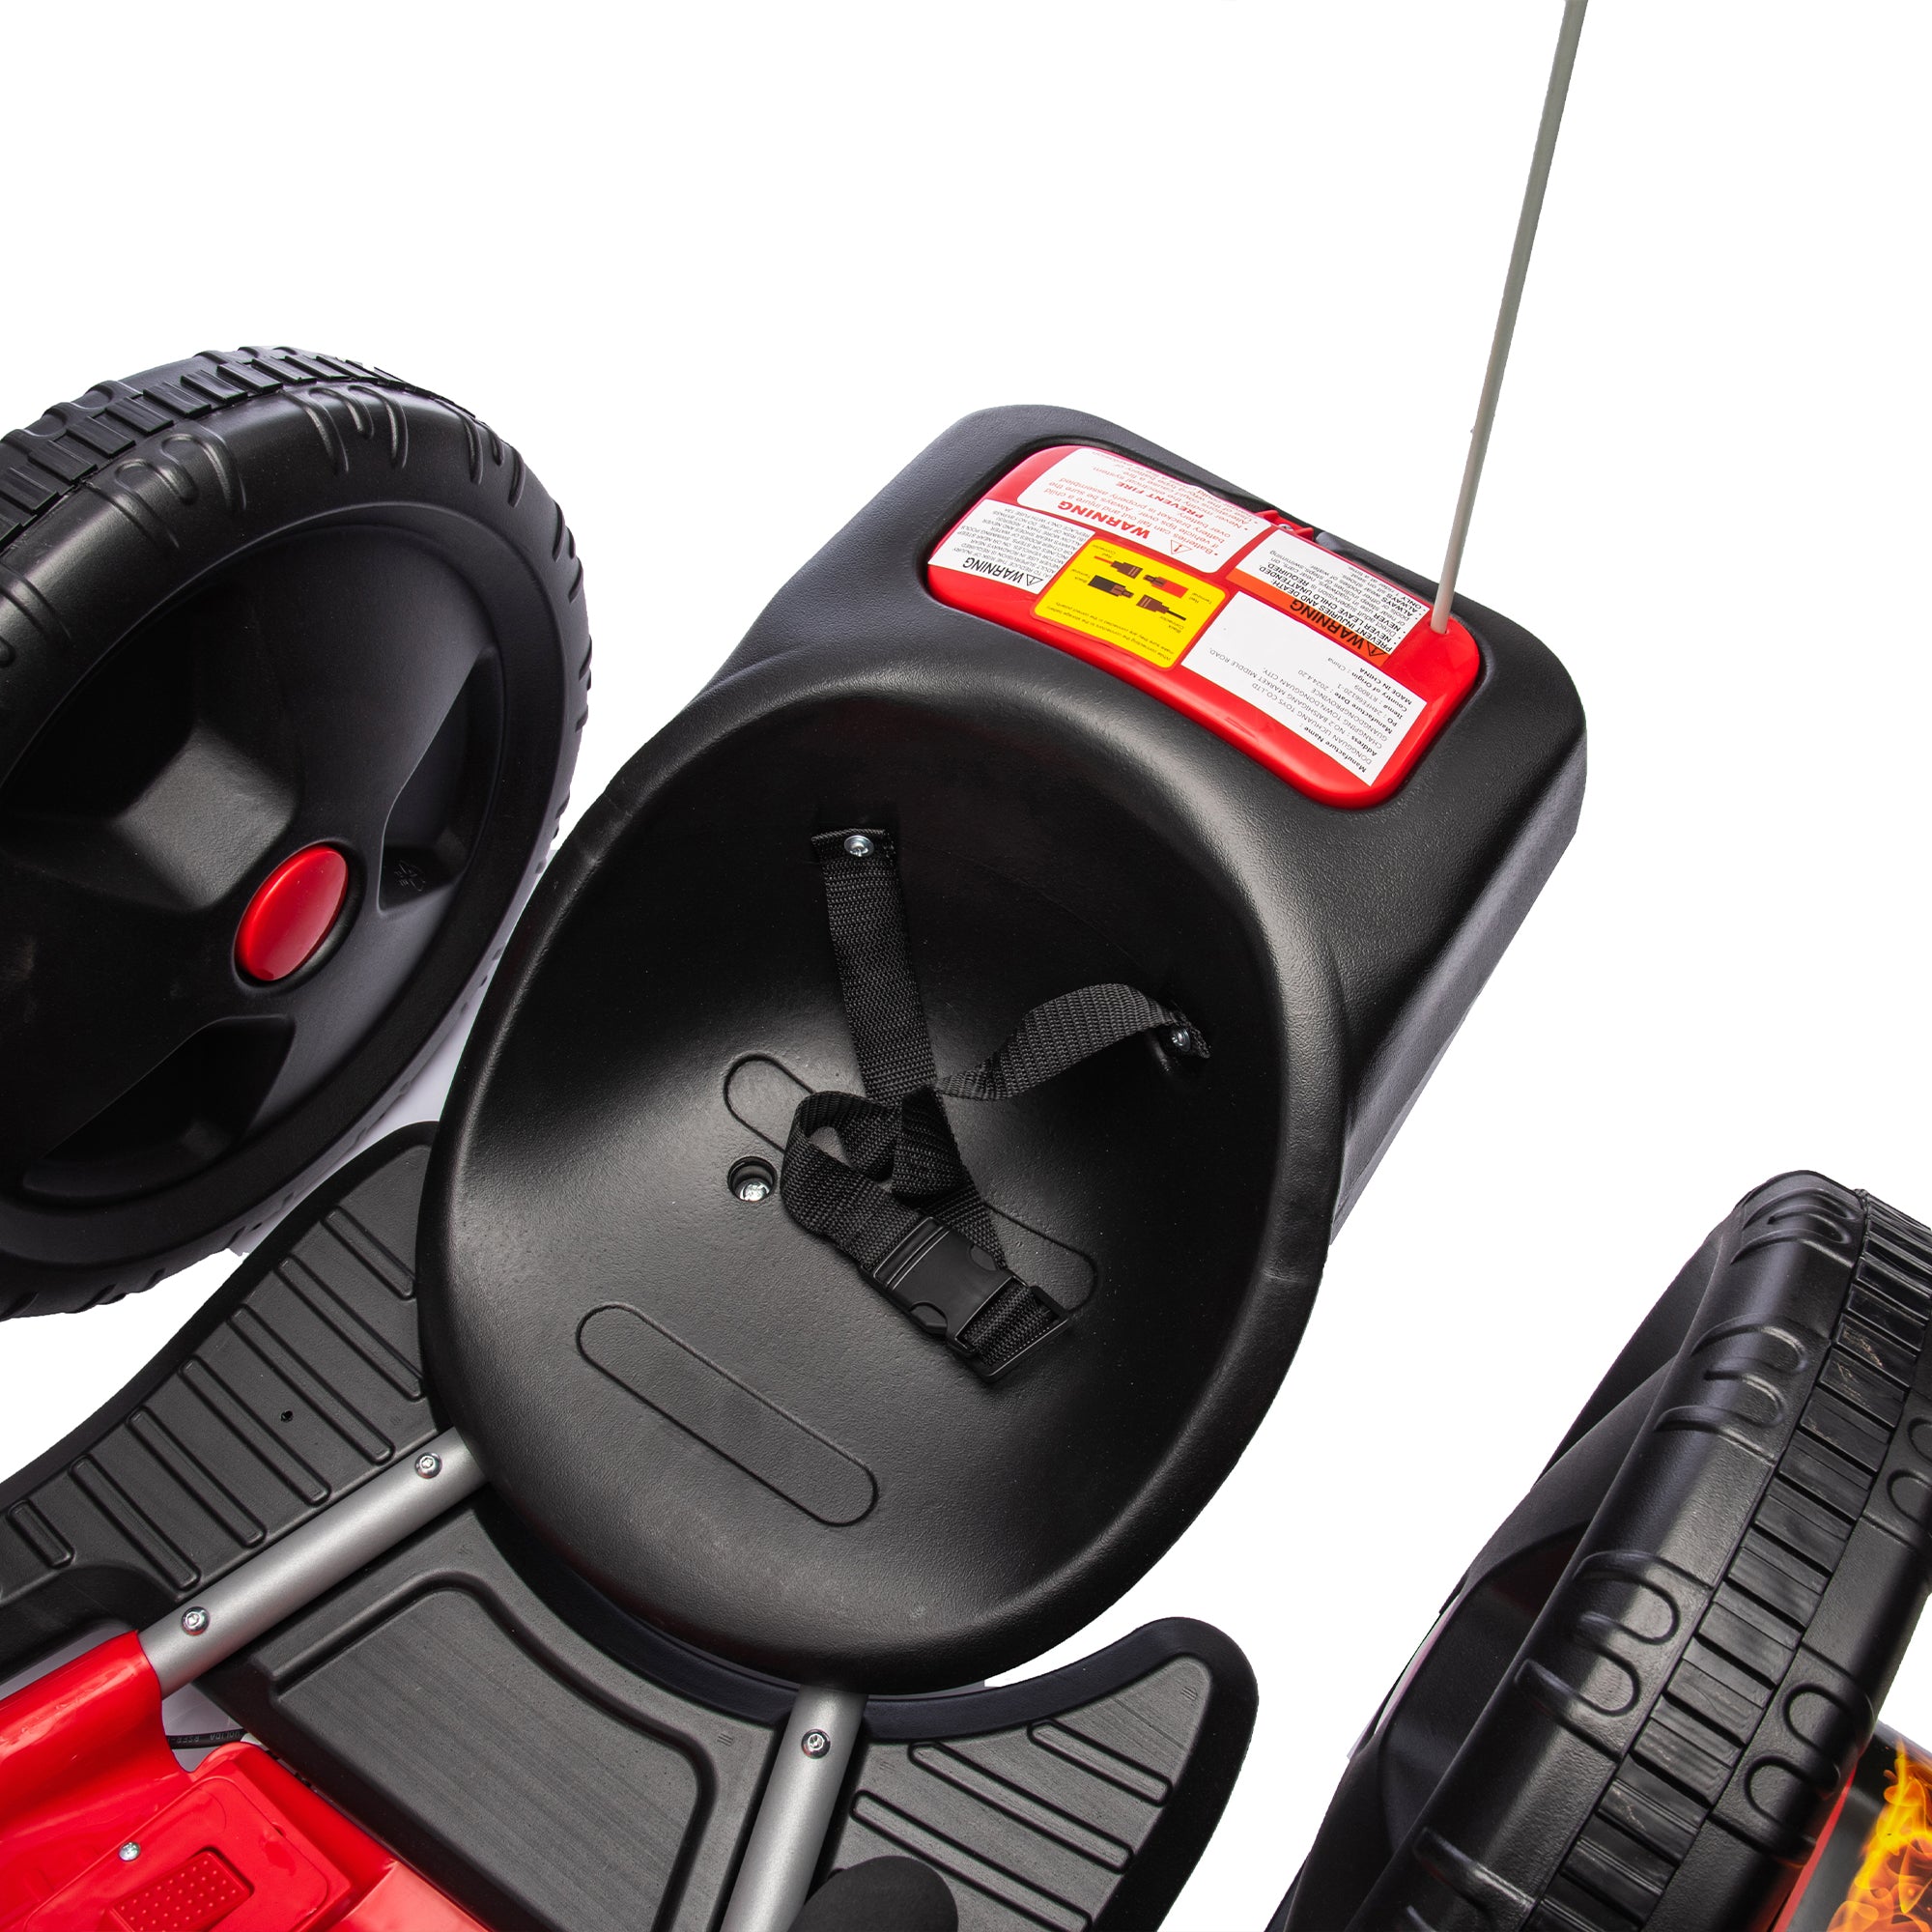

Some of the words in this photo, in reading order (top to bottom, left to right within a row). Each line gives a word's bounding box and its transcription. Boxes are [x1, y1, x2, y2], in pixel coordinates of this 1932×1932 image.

[1043, 488, 1065, 497] child
[1058, 477, 1108, 496] assembled
[1065, 486, 1085, 495] sure
[1116, 481, 1144, 494] FIRE
[1124, 478, 1165, 496] electrical
[1073, 496, 1102, 508] injure
[1097, 497, 1134, 512] Always
[1108, 493, 1147, 509] properly
[1145, 492, 1204, 518] PREVENT
[1183, 500, 1214, 515] modify
[1100, 505, 1121, 515] and
[1120, 512, 1137, 521] out
[1055, 499, 1151, 538] WARNING
[1155, 512, 1191, 528] bracket
[1159, 519, 1178, 529] tips
[1214, 514, 1241, 528] Never
[1153, 525, 1171, 534] can
[1177, 527, 1210, 545] vehicle
[1191, 526, 1226, 543] battery
[1210, 526, 1231, 537] over
[1171, 533, 1213, 554] Batteries
[960, 556, 1026, 582] WARNING
[1038, 558, 1061, 568] NEVER
[1265, 561, 1309, 586] REQUIRED.
[1299, 571, 1316, 582] near
[1269, 579, 1299, 597] DEATH:
[1332, 582, 1359, 599] inclines
[1338, 579, 1362, 594] bodies
[1364, 586, 1380, 597] wear
[1378, 582, 1394, 593] rider
[1299, 594, 1319, 607] AND
[1312, 593, 1338, 610] CHILD
[1317, 586, 1358, 612] supervision
[1359, 597, 1380, 611] steep
[1361, 592, 1380, 605] other
[1380, 596, 1412, 617] ALWAYS
[1385, 593, 1417, 612] ALWAYS
[1401, 595, 1421, 609] ONLY
[1337, 608, 1363, 625] LEAVE
[1356, 610, 1375, 623] adult
[1359, 604, 1373, 613] use
[1379, 610, 1396, 620] near
[1389, 607, 1410, 621] pools
[1288, 598, 1367, 649] WARNING
[1318, 605, 1354, 629] INJURIES
[1373, 612, 1401, 631] NEVER
[1363, 623, 1392, 642] NEVER
[1374, 621, 1396, 637] Direct
[1353, 626, 1392, 651] PREVENT
[1230, 660, 1257, 678] MIDDLE
[1326, 657, 1346, 670] China
[1297, 668, 1328, 690] 2024.4.20
[1350, 670, 1373, 688] Origin
[1358, 668, 1381, 684] CHINA
[1257, 675, 1286, 696] MARKET
[1372, 685, 1380, 694] of
[1333, 691, 1350, 704] Date
[1381, 690, 1407, 712] Country
[1391, 688, 1411, 704] MADE
[1277, 698, 1295, 712] TOYS
[1286, 693, 1328, 722] BAISHIGANG
[1382, 703, 1403, 719] Item#
[1310, 687, 1387, 741] GUANGDONGPROVINCE
[1350, 702, 1392, 734] Manufacture
[1386, 716, 1397, 726] PO
[1296, 710, 1331, 736] LICHUANG
[1327, 720, 1346, 734] NO.2
[1302, 725, 1323, 742] Name
[1342, 719, 1382, 749] CHANGPING
[1331, 734, 1372, 764] DONGGUAN
[1350, 734, 1377, 756] Address
[1324, 740, 1366, 772] Manufacture
